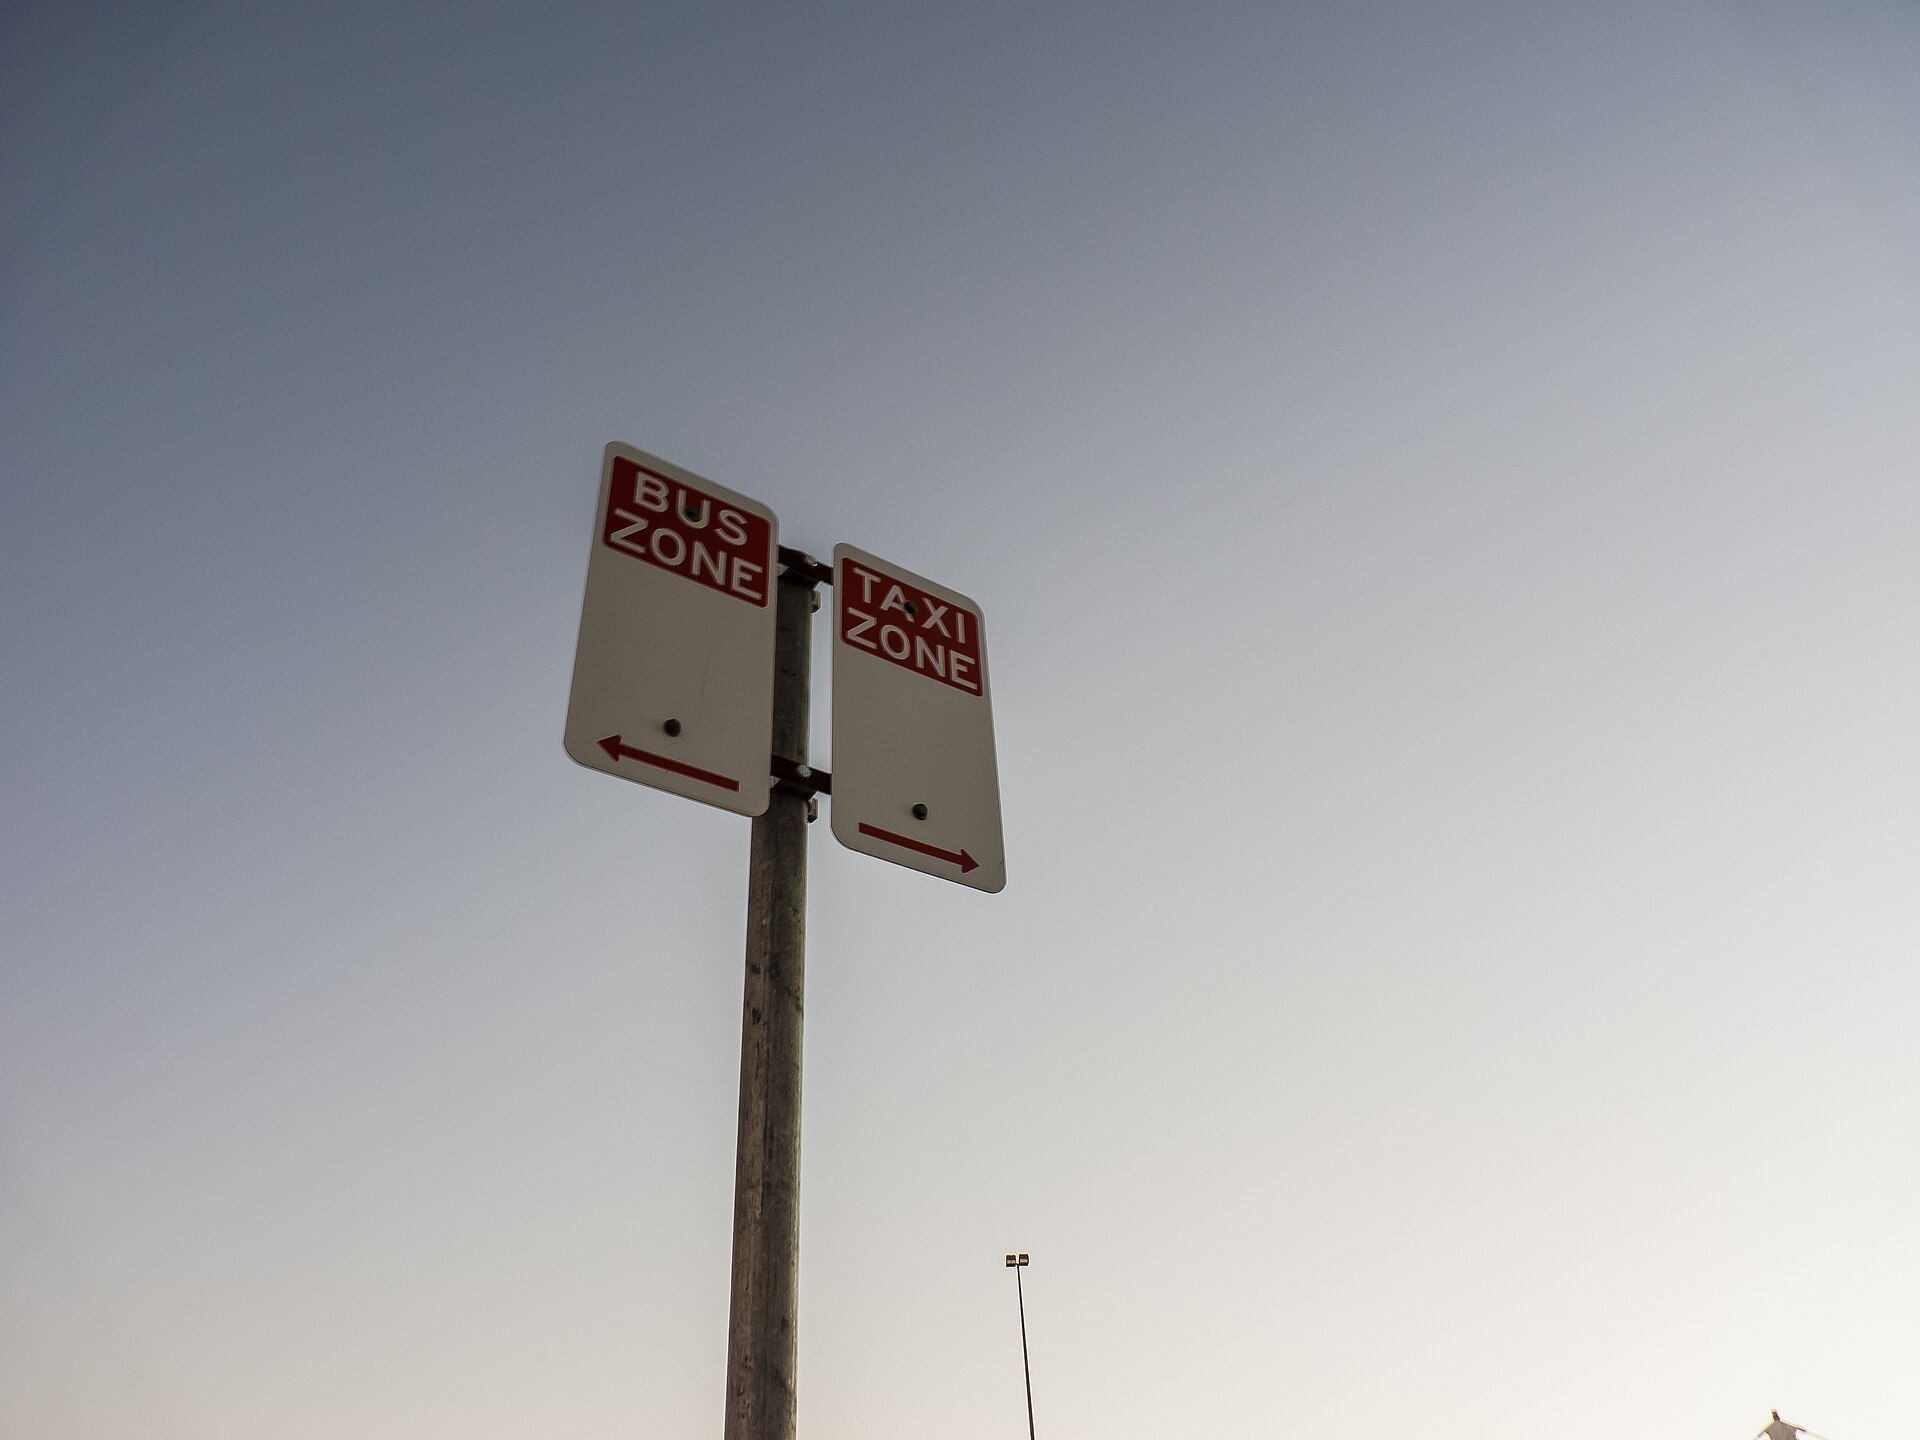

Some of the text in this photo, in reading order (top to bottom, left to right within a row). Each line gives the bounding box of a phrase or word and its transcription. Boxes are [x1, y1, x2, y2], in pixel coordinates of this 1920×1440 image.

[633, 471, 748, 546] BUS
[610, 507, 763, 600] ZONE
[853, 567, 966, 644] TAXI
[847, 607, 978, 690] ZONE
